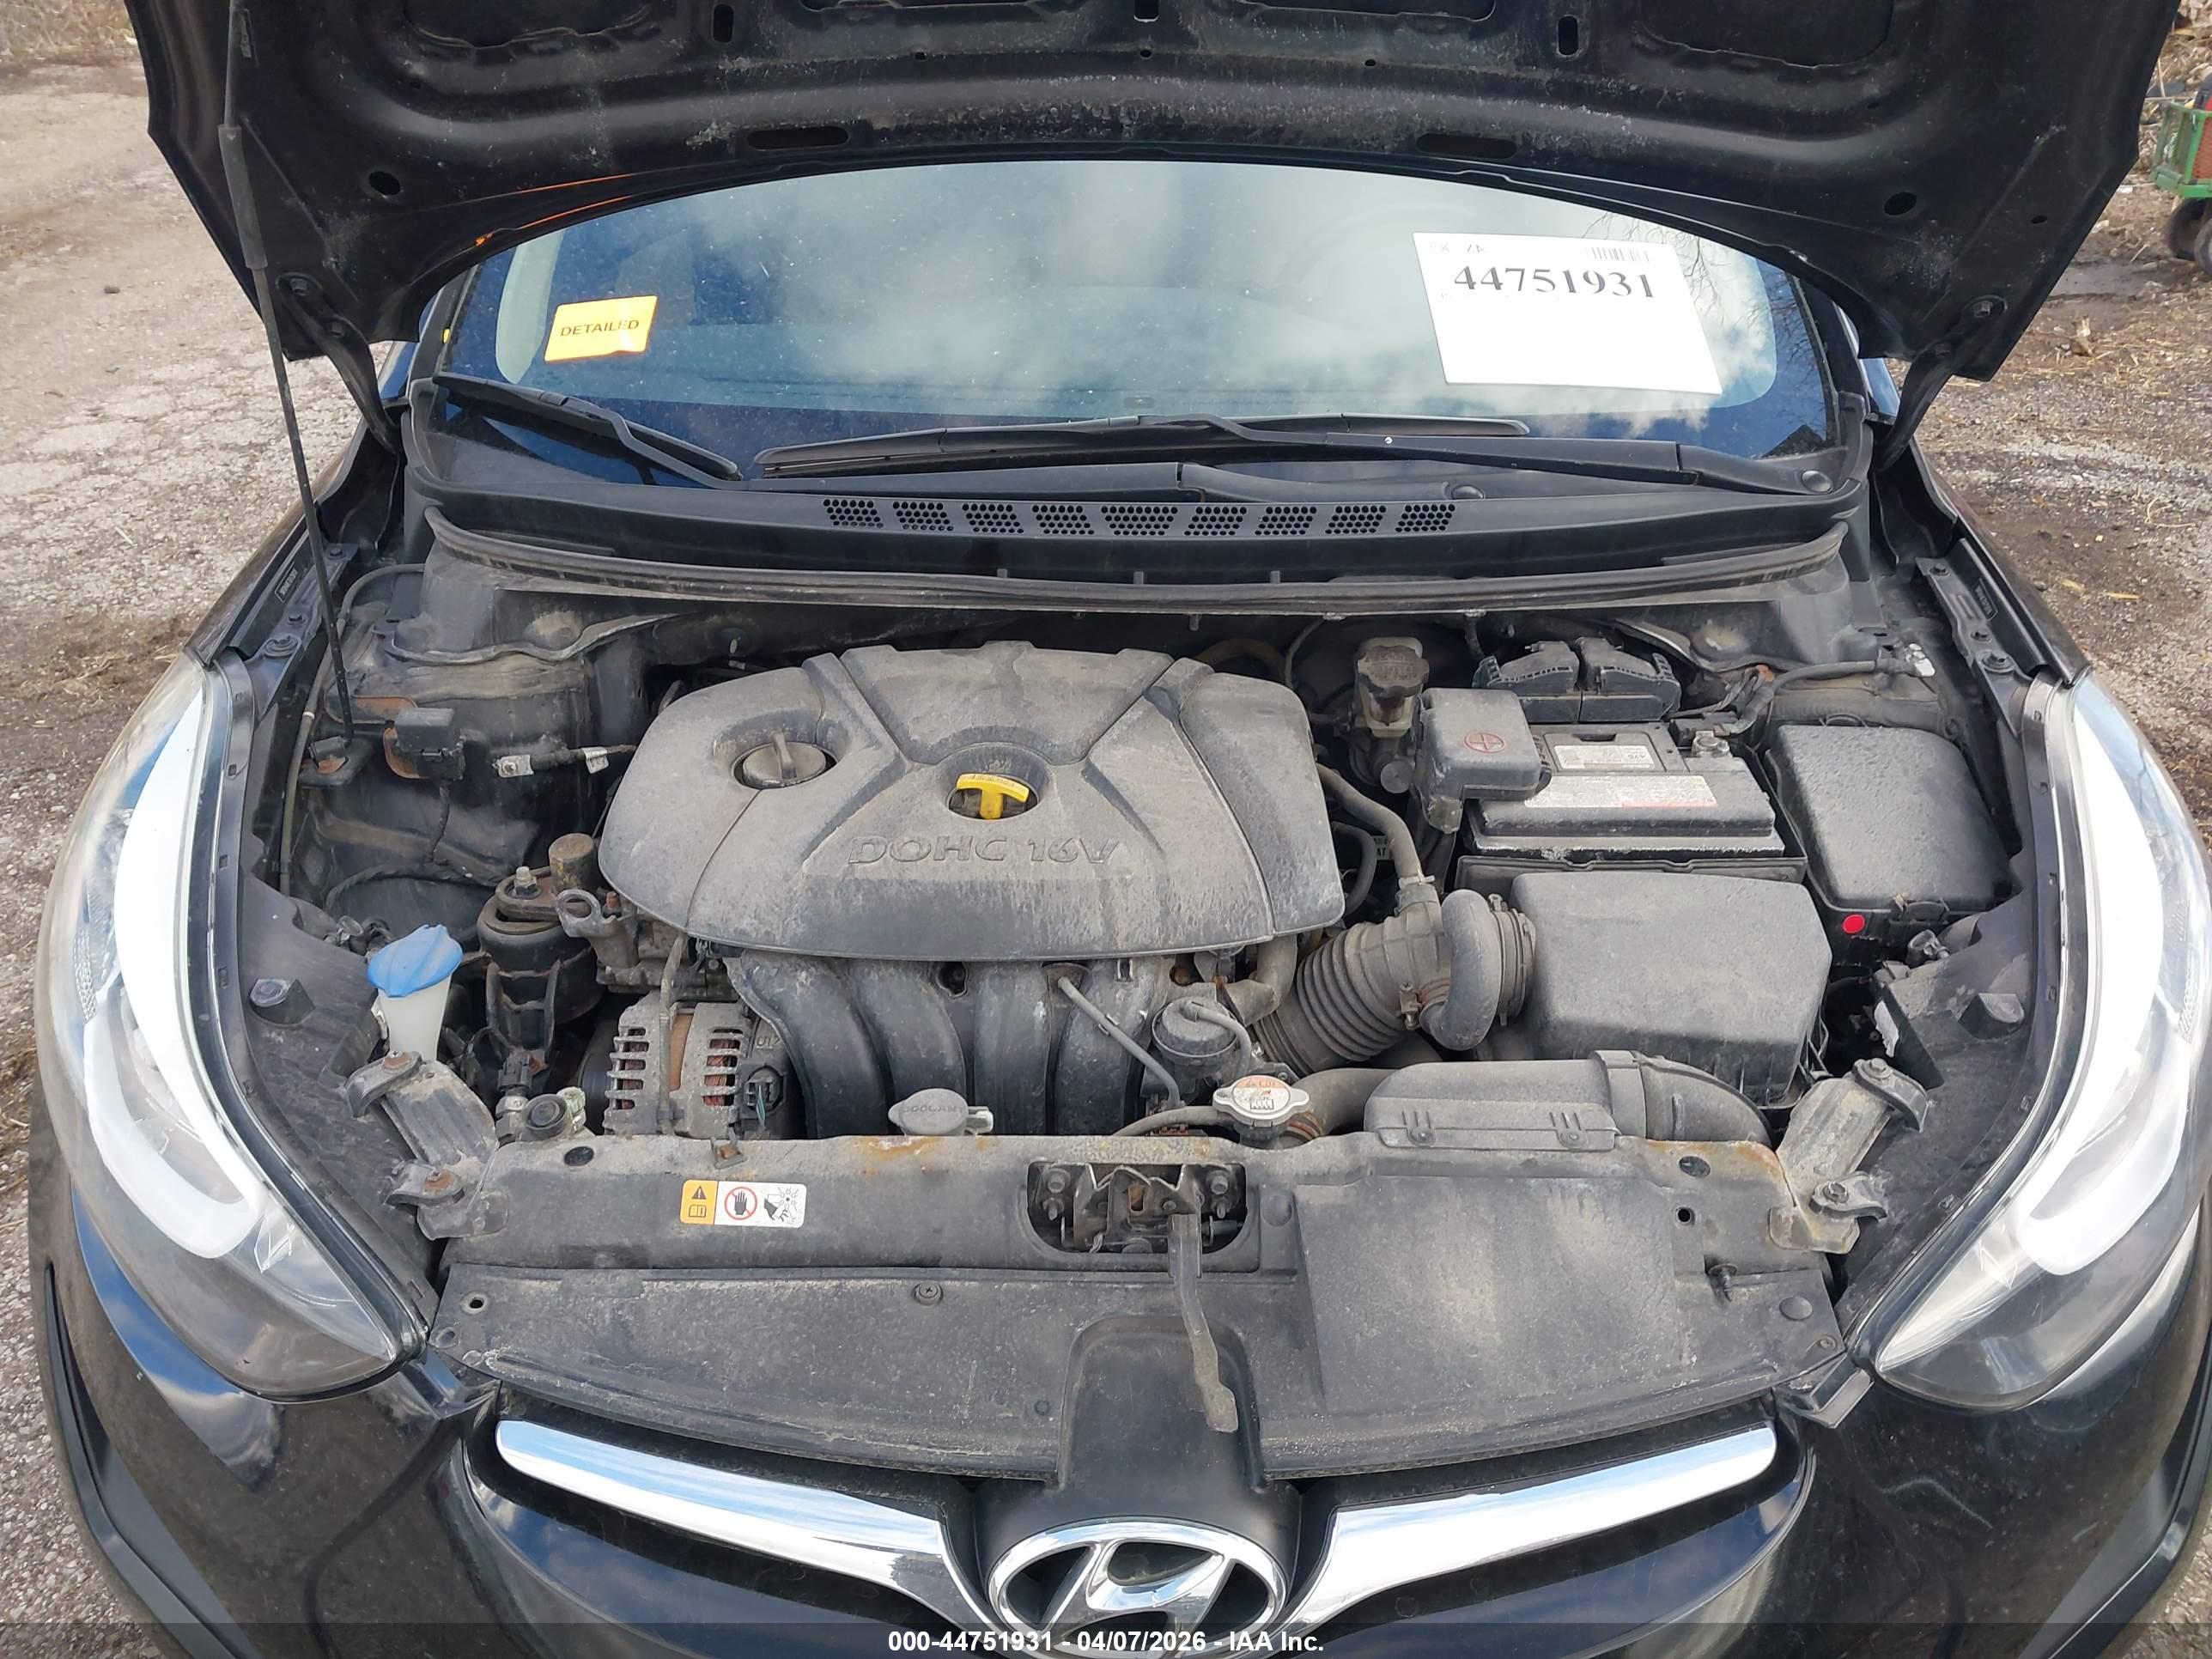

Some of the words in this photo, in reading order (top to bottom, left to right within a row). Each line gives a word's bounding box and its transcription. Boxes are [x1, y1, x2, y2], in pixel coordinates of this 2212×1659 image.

[1454, 265, 1654, 298] 44751931
[560, 319, 640, 337] DETAILED
[848, 836, 1008, 865] DOHC
[1028, 836, 1120, 865] 16V
